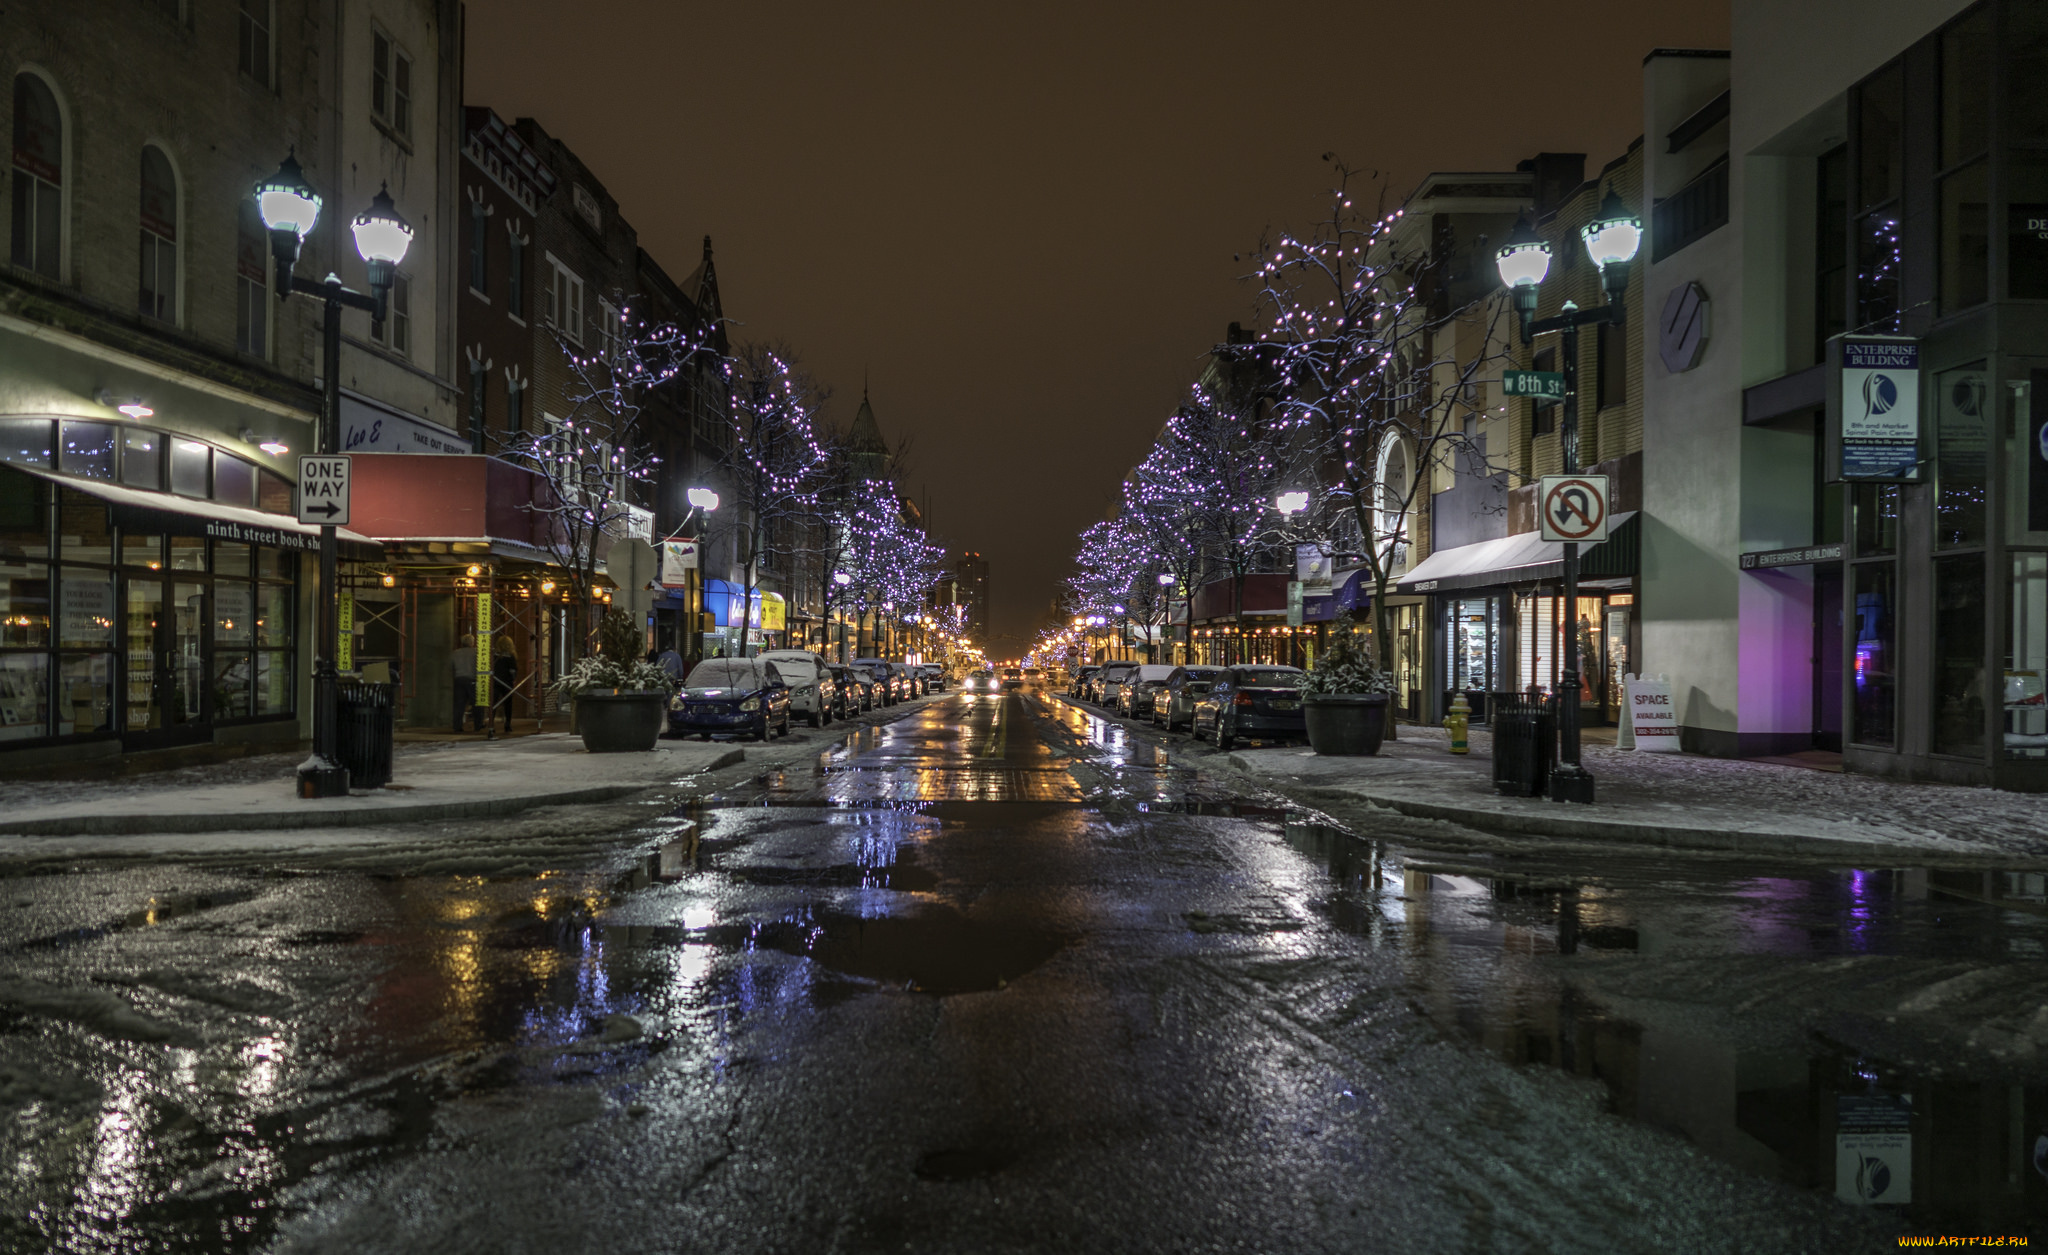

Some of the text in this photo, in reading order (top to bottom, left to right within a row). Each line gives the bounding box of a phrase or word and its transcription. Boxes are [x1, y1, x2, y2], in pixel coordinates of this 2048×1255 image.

[1846, 344, 1917, 355] ENTERPRISE
[1852, 355, 1910, 366] BUILDING
[1504, 374, 1561, 394] W 8th St
[346, 425, 367, 451] Leo
[413, 432, 429, 446] TAKE
[431, 440, 442, 451] OUT
[306, 462, 344, 479] ONE
[304, 481, 345, 497] WAY
[207, 521, 241, 539] ninth
[244, 528, 277, 544] street
[280, 530, 305, 549] book
[1742, 547, 1841, 568] 727 ENTERPRISE BUILDING
[128, 646, 154, 661] ninth
[128, 670, 154, 681] street
[128, 687, 151, 702] book
[1635, 694, 1670, 705] SPACE
[128, 708, 150, 725] shop
[1636, 712, 1673, 720] AVAILABLE
